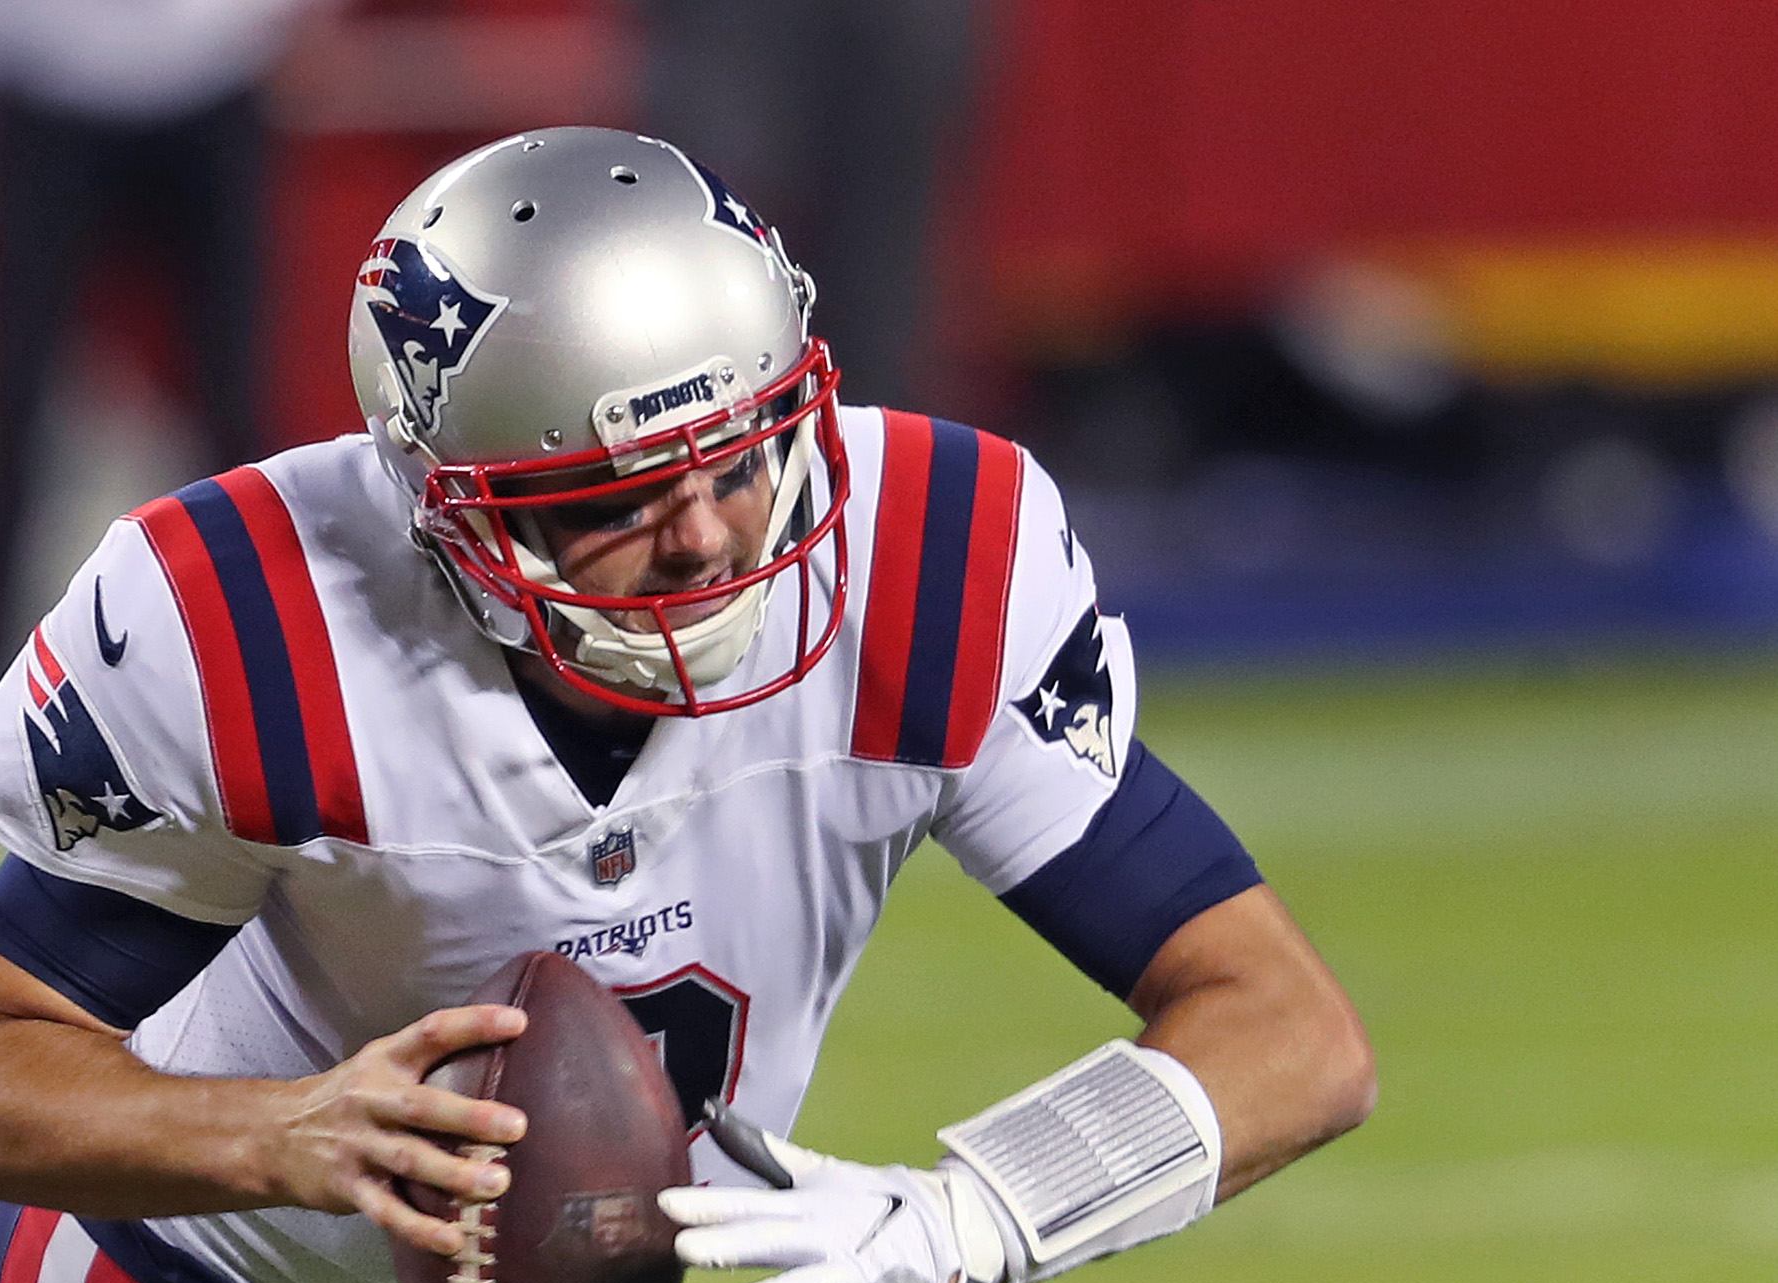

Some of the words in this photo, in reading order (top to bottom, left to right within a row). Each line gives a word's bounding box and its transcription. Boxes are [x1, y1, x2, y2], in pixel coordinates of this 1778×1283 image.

[628, 373, 714, 428] PATRIOTS
[597, 850, 634, 881] NFL
[555, 900, 693, 962] PATRIOTS
